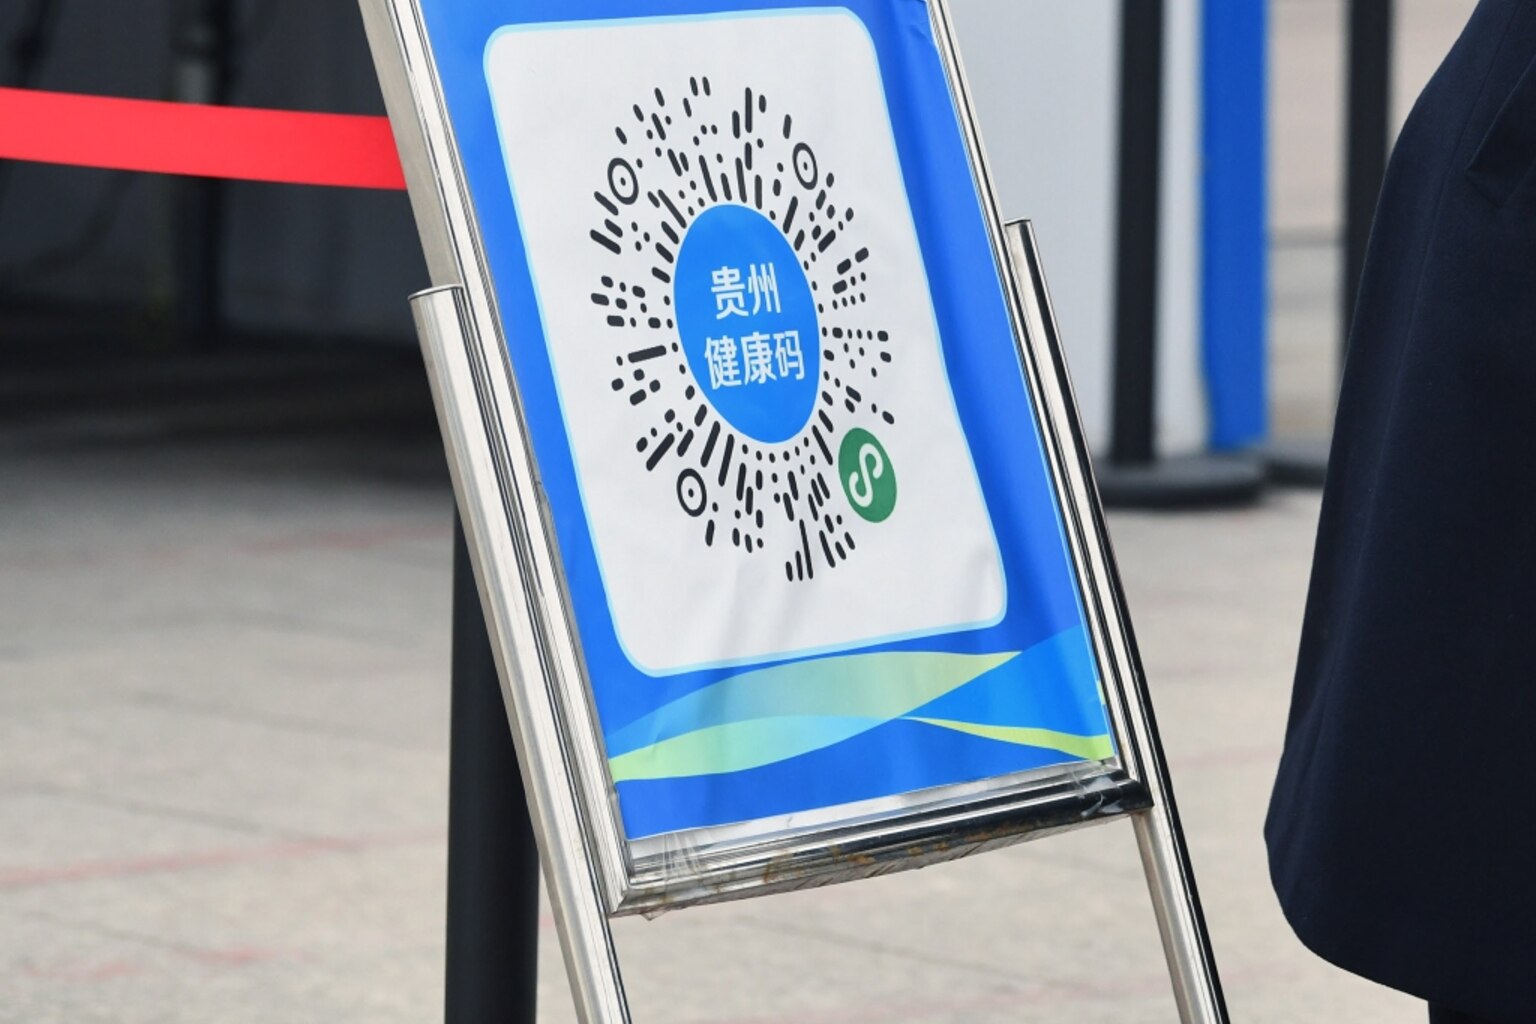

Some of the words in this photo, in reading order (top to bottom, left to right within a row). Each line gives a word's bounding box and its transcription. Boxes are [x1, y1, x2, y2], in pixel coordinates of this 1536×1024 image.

[710, 262, 782, 320] 贵州
[704, 330, 806, 390] 健康码
